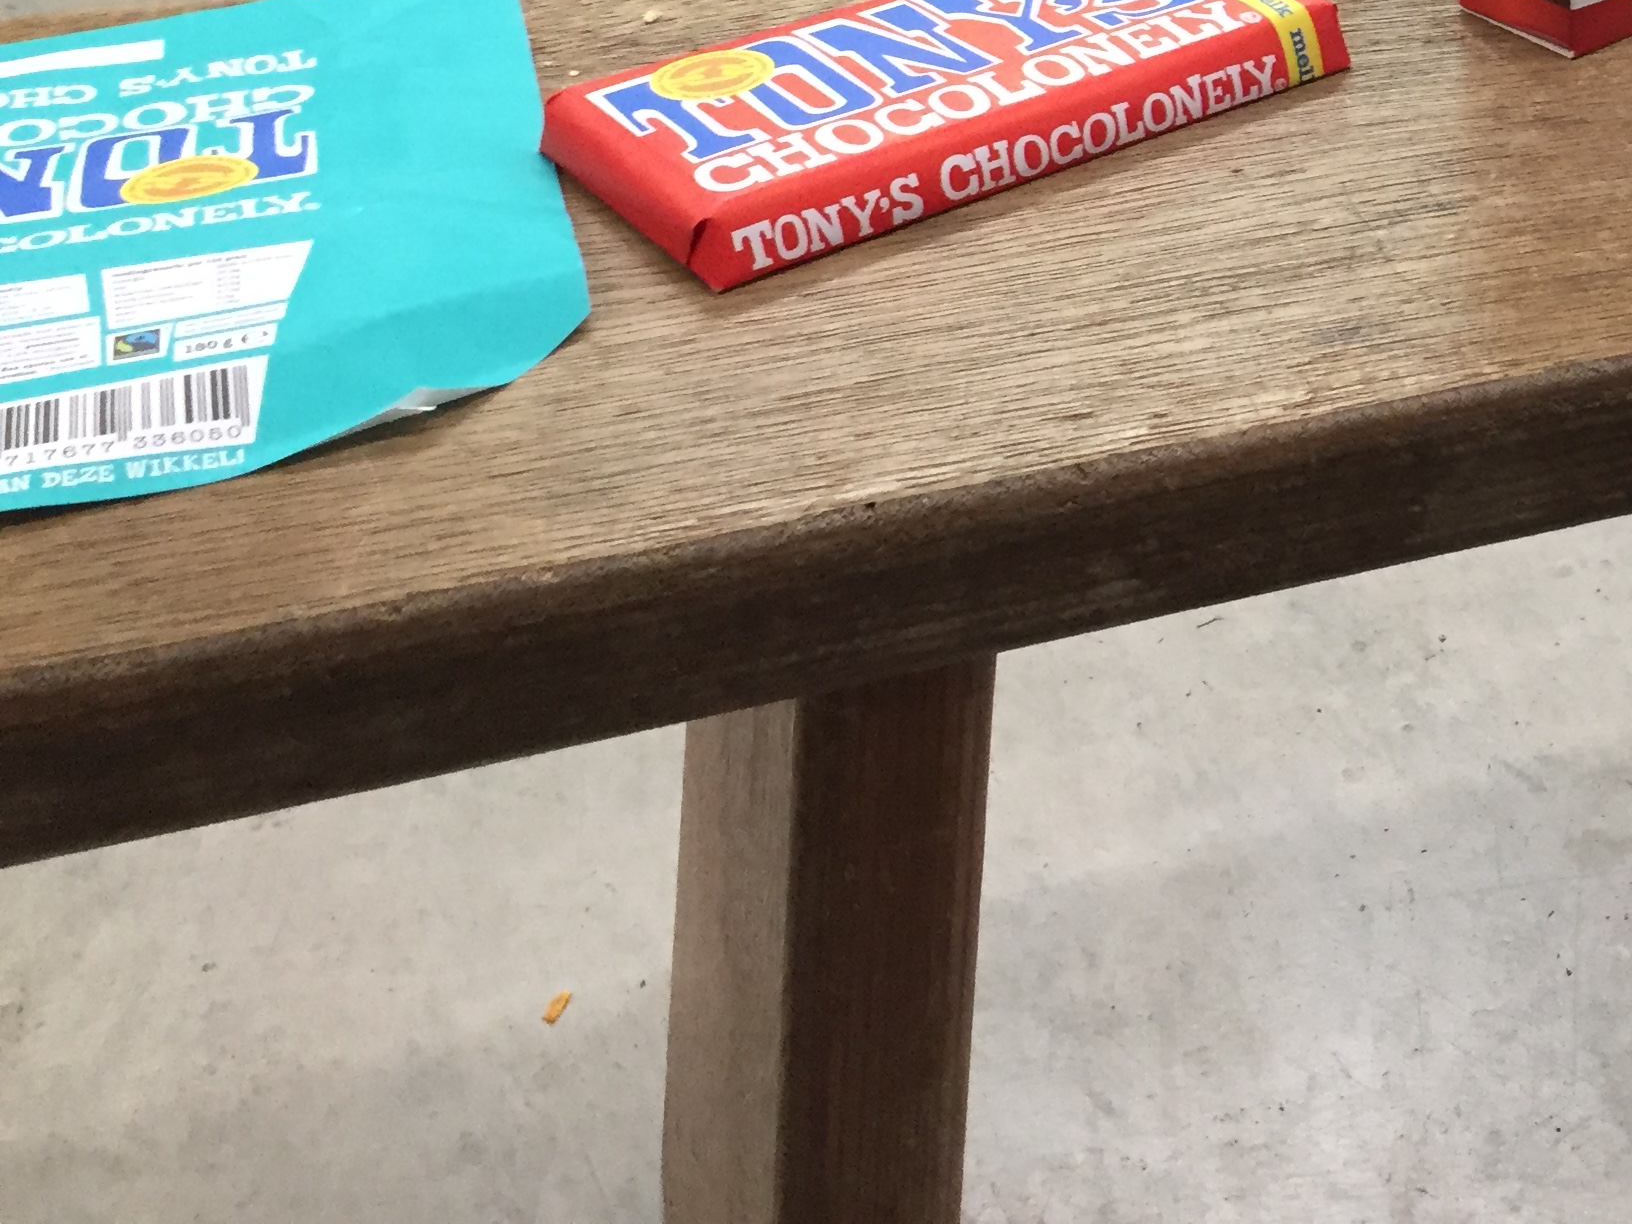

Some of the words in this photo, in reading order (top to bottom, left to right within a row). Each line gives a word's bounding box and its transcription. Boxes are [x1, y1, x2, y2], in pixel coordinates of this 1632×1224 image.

[1290, 27, 1315, 83] mel
[730, 175, 925, 271] TONY'S
[41, 463, 116, 489] DEZE
